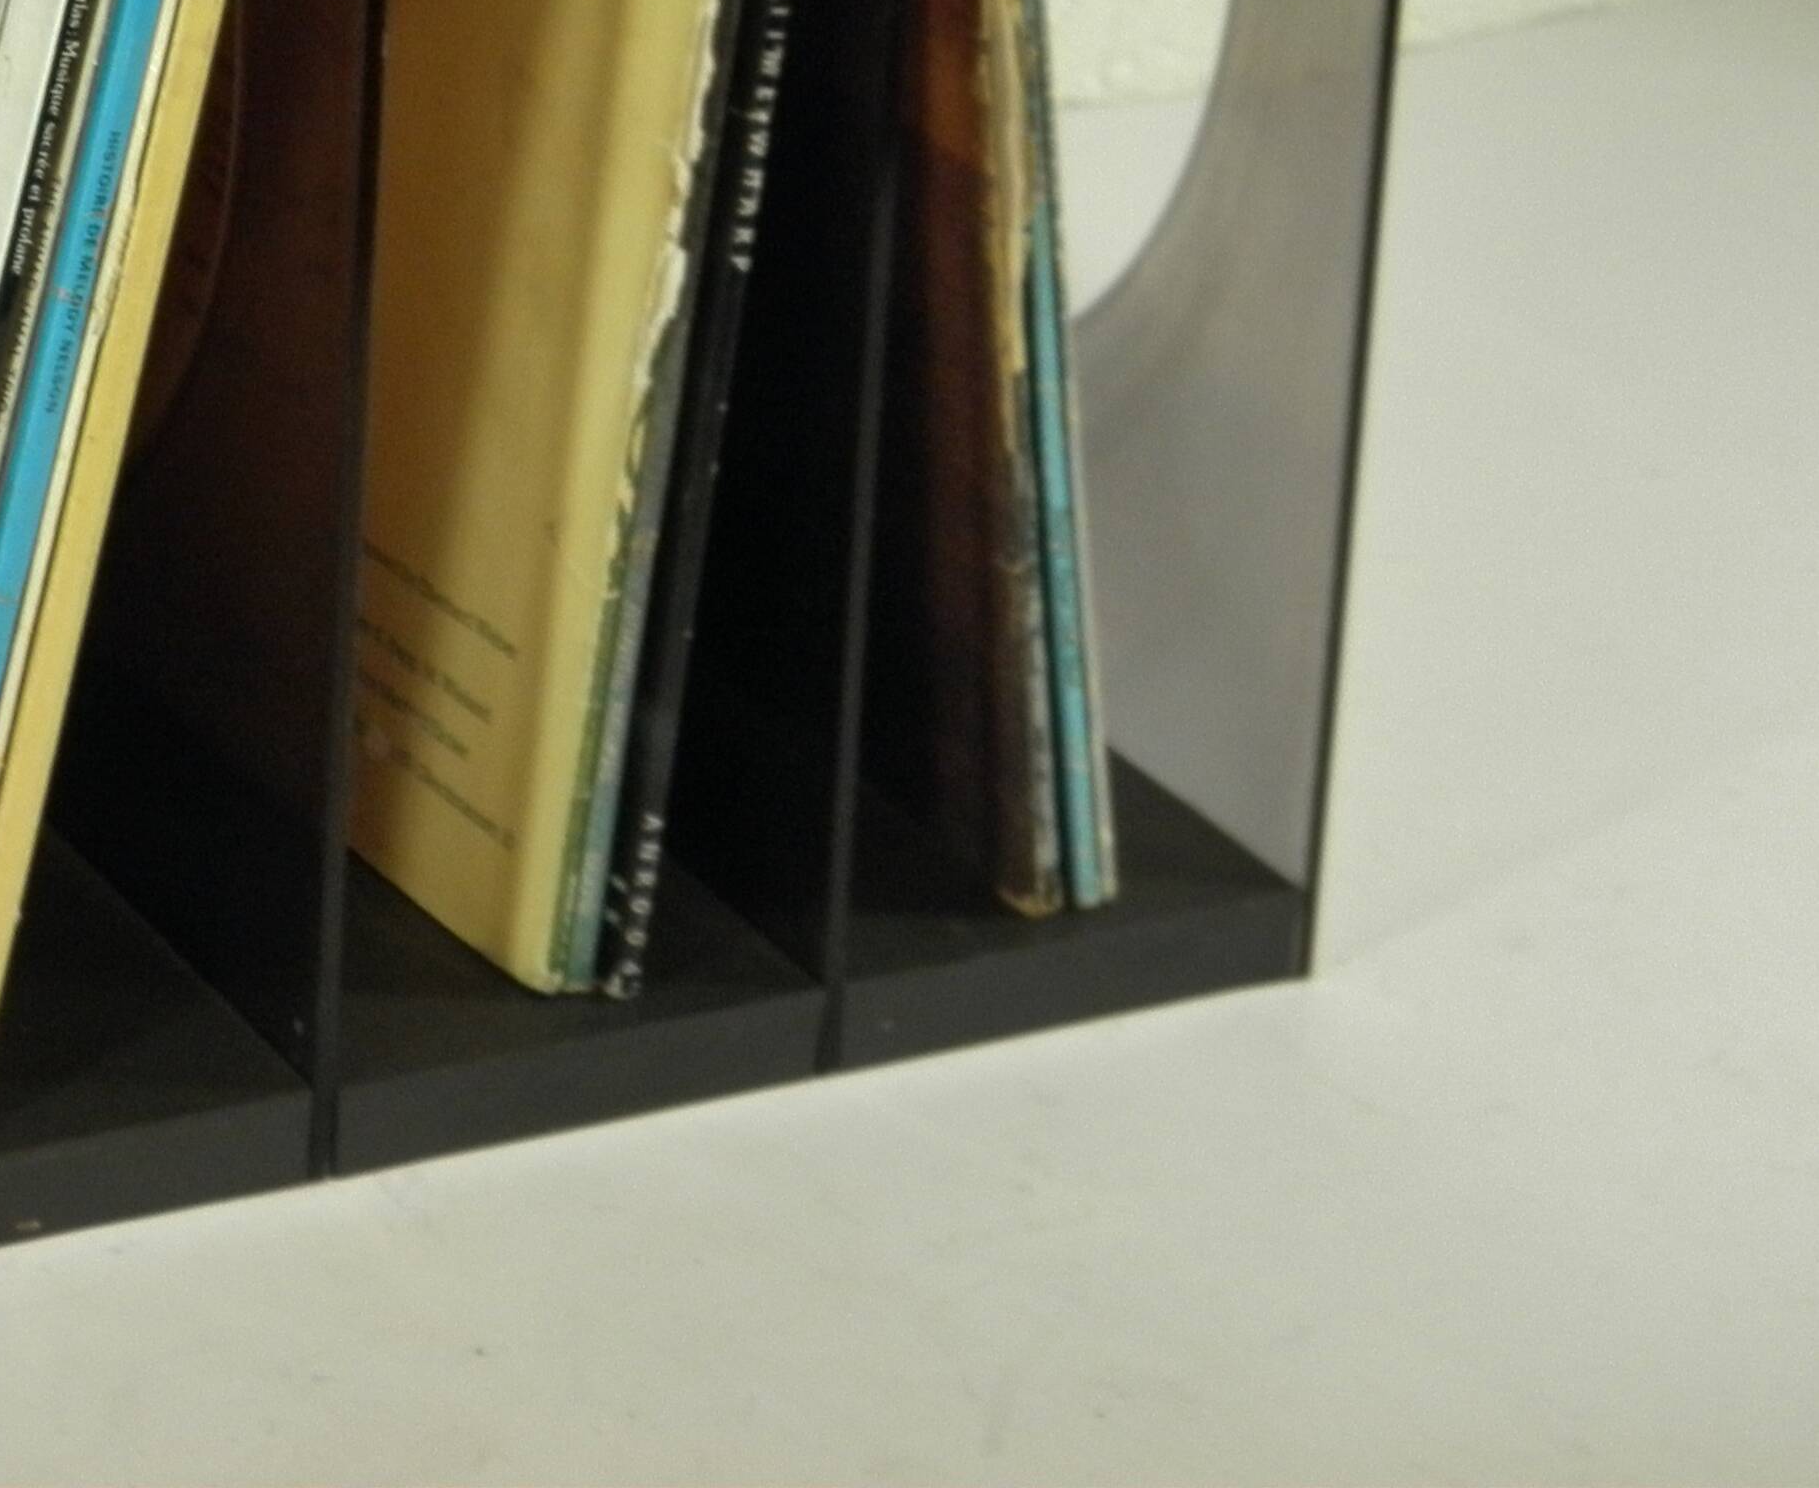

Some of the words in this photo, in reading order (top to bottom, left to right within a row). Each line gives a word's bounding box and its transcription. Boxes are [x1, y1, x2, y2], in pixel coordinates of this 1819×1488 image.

[48, 39, 80, 117] Musique
[35, 120, 63, 181] sacrée
[92, 130, 122, 217] HISTOIRE
[28, 183, 44, 203] et
[11, 206, 39, 277] profane
[80, 222, 100, 255] DE
[62, 254, 96, 334] MELODY
